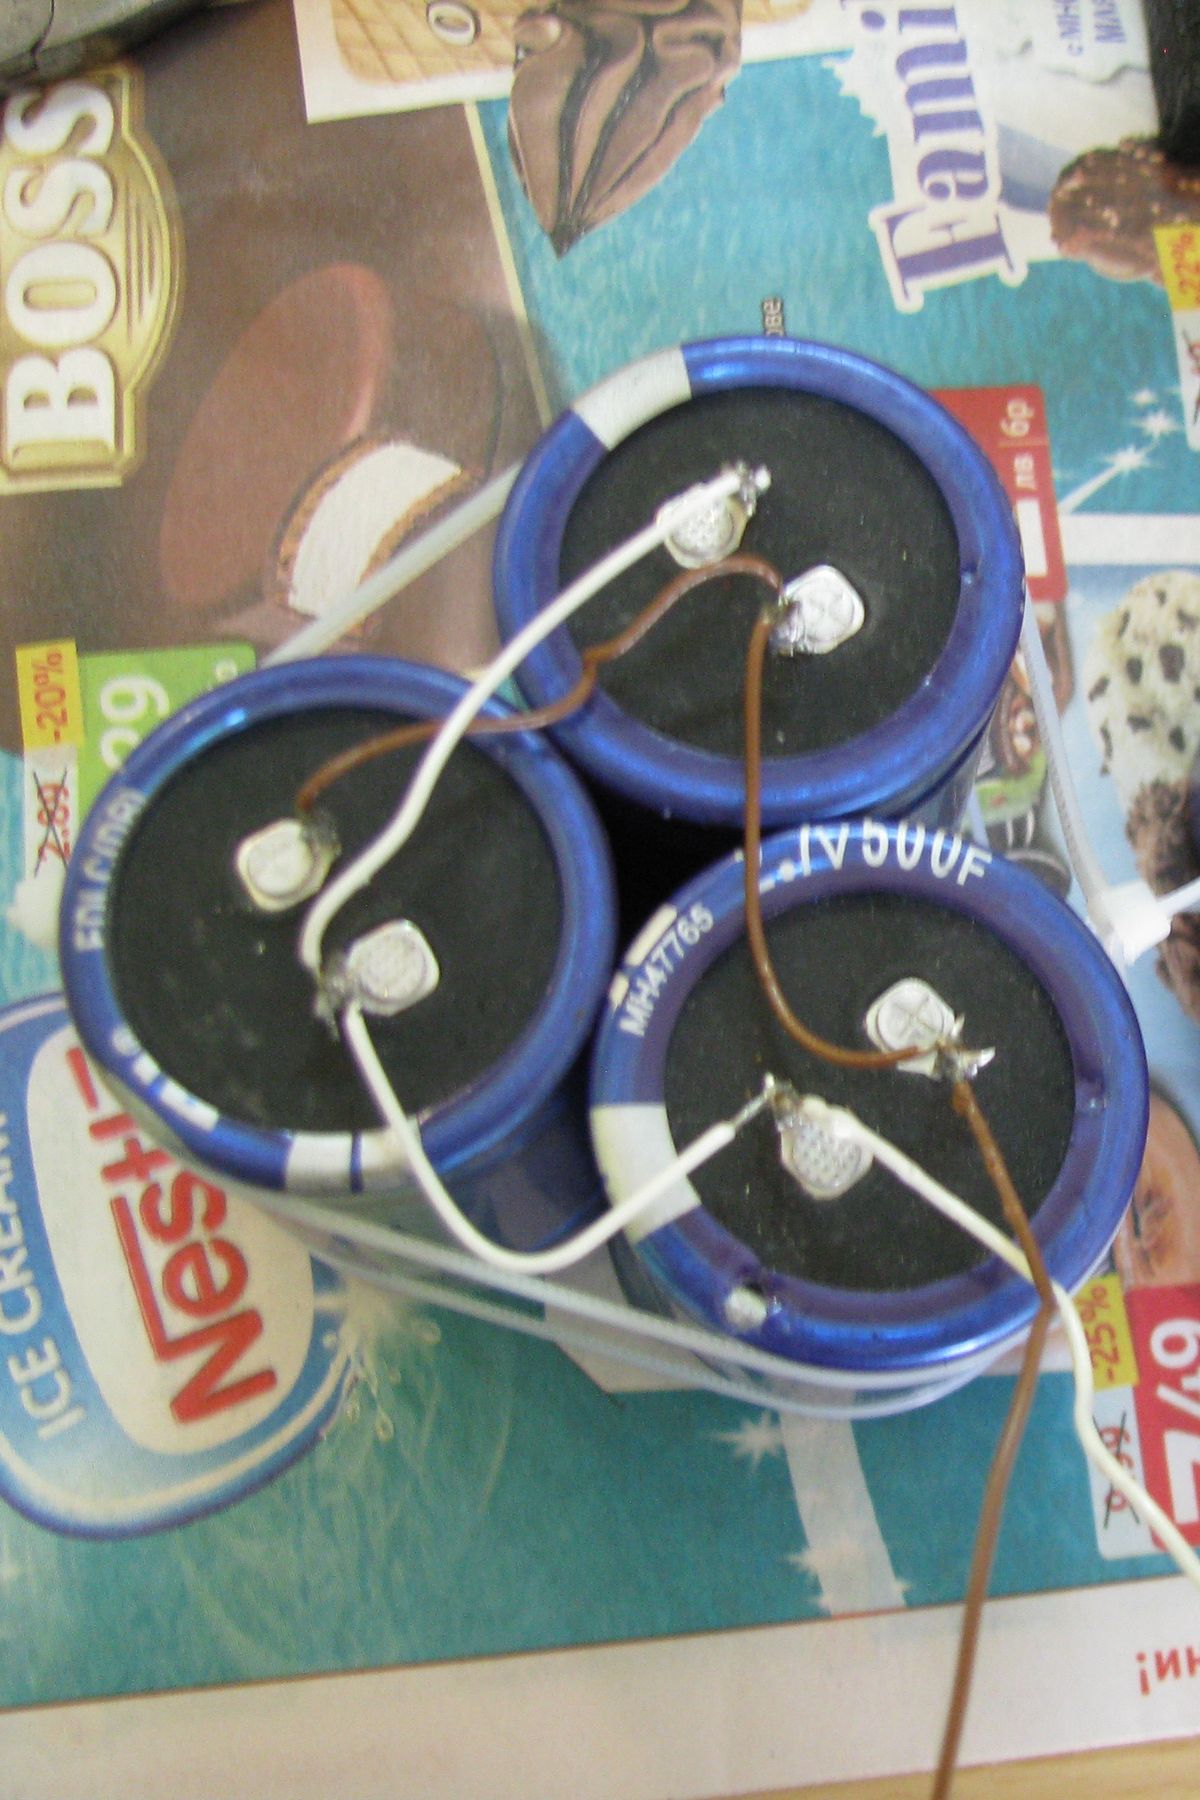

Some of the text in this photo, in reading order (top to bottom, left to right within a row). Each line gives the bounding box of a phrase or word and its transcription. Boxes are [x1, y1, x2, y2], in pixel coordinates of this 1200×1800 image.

[4, 82, 118, 458] BOSS
[33, 652, 69, 745] -20%
[1080, 1284, 1121, 1382] -25%
[8, 1336, 87, 1441] ICE
